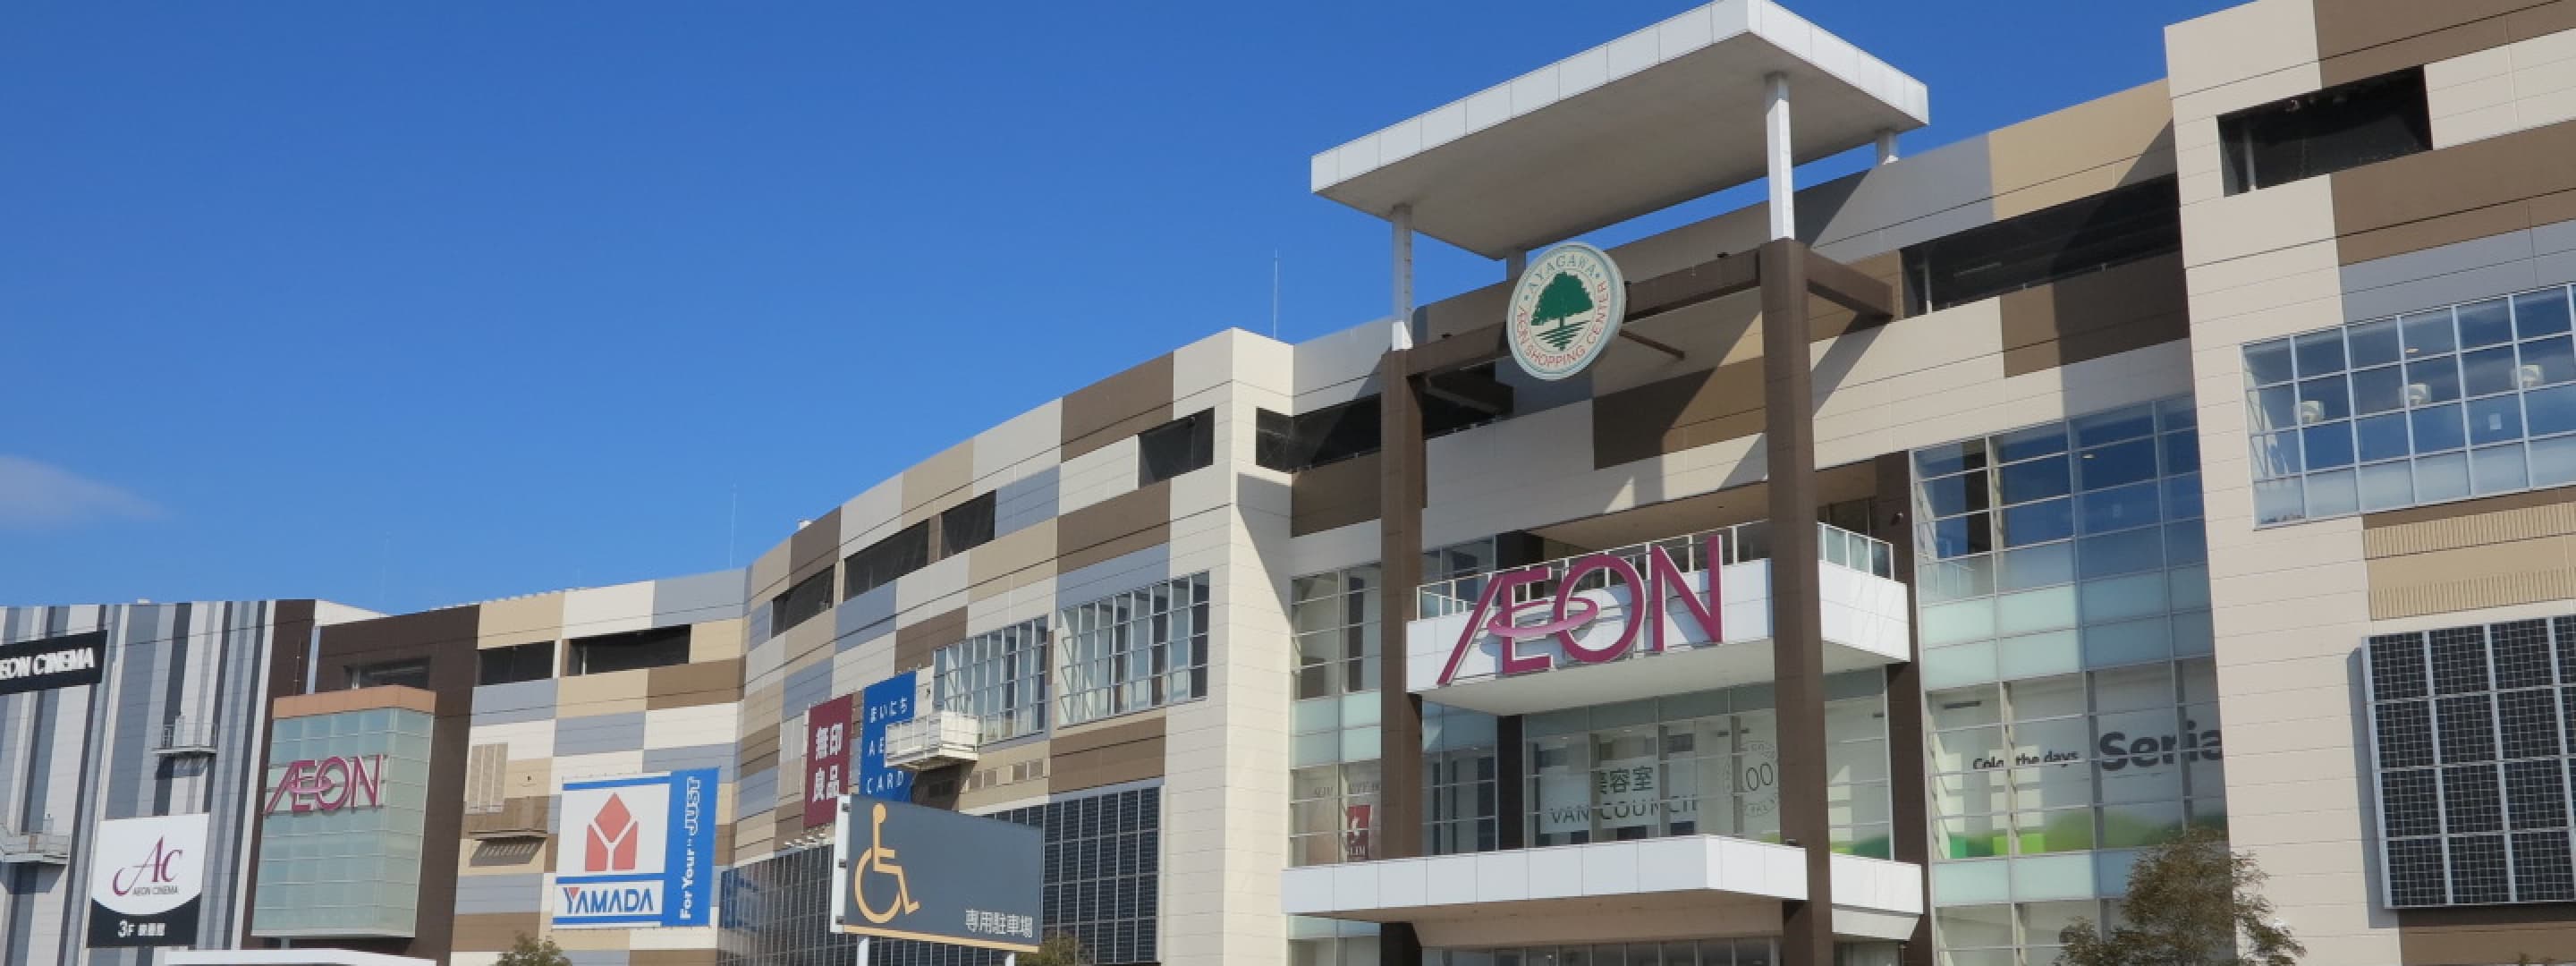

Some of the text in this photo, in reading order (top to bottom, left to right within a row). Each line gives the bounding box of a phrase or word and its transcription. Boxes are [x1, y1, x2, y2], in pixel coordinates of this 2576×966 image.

[1525, 344, 1586, 368] SHOPPING
[1586, 280, 1609, 344] CENTER
[33, 647, 94, 675] CINEMA
[870, 695, 908, 724] まいにち
[2099, 719, 2223, 771] Seria
[1973, 750, 2080, 770] Colo the days
[867, 770, 904, 795] CARD
[684, 775, 701, 836] JUST
[1550, 804, 1589, 824] VAN
[563, 886, 654, 914] YAMADA
[680, 891, 693, 920] For
[965, 908, 1033, 938] 専用駐車場
